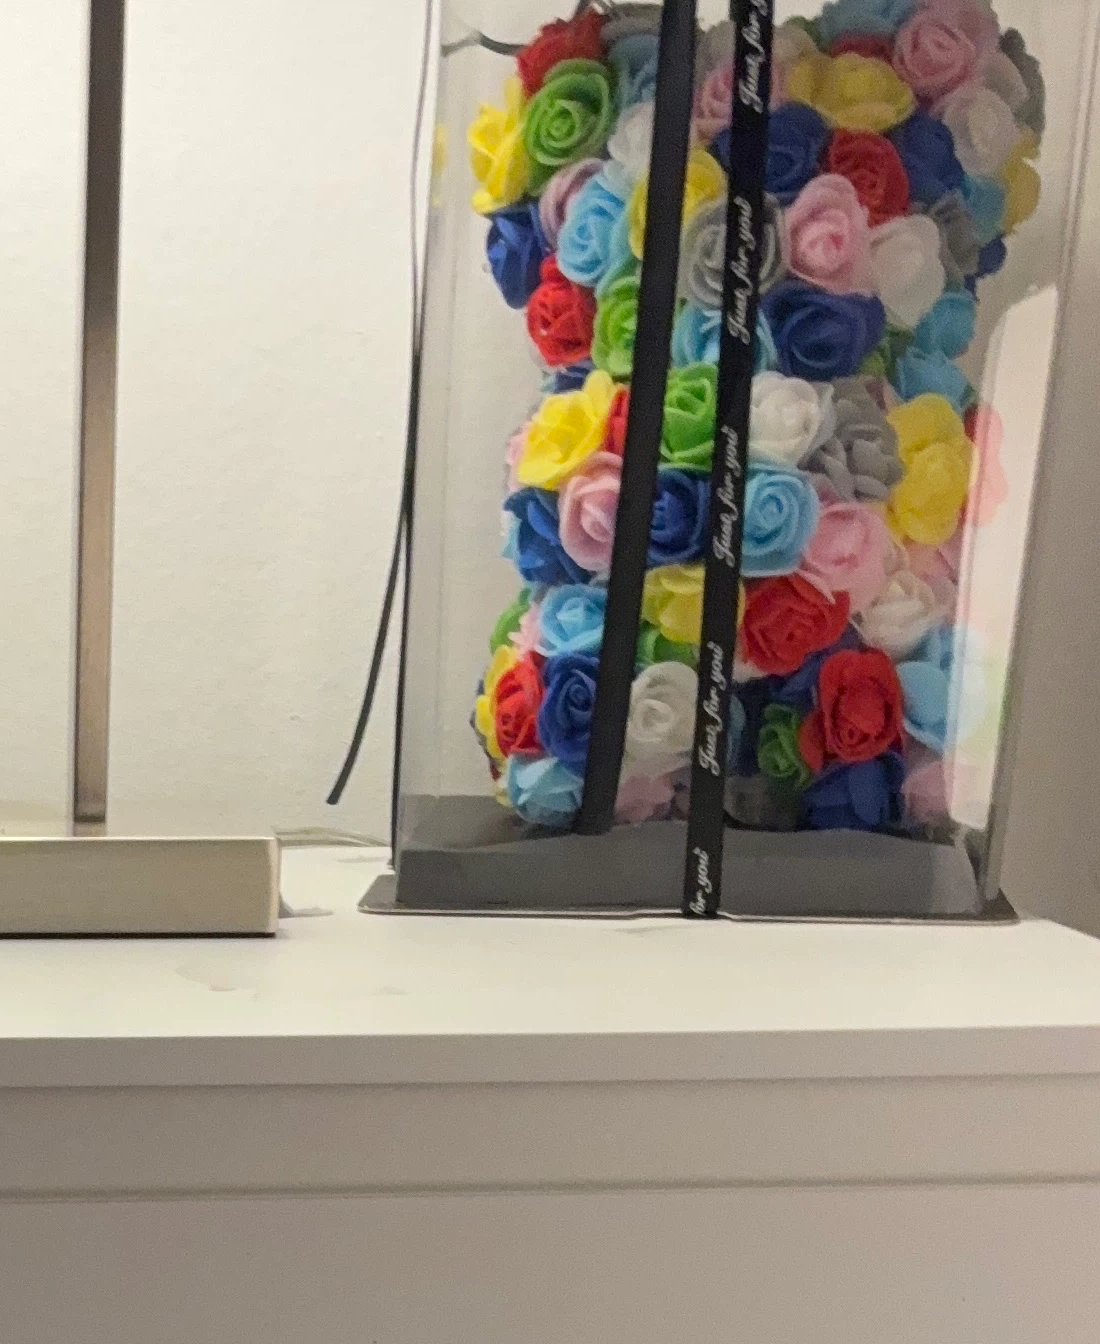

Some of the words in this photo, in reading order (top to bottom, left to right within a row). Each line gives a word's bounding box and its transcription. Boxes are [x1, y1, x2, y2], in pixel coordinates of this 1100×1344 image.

[740, 10, 766, 62] for
[738, 53, 764, 113] Just
[730, 245, 753, 296] for
[727, 287, 750, 345] Just
[716, 471, 738, 521] for
[712, 512, 735, 568] Just
[703, 685, 723, 732] for
[699, 724, 720, 776] Just
